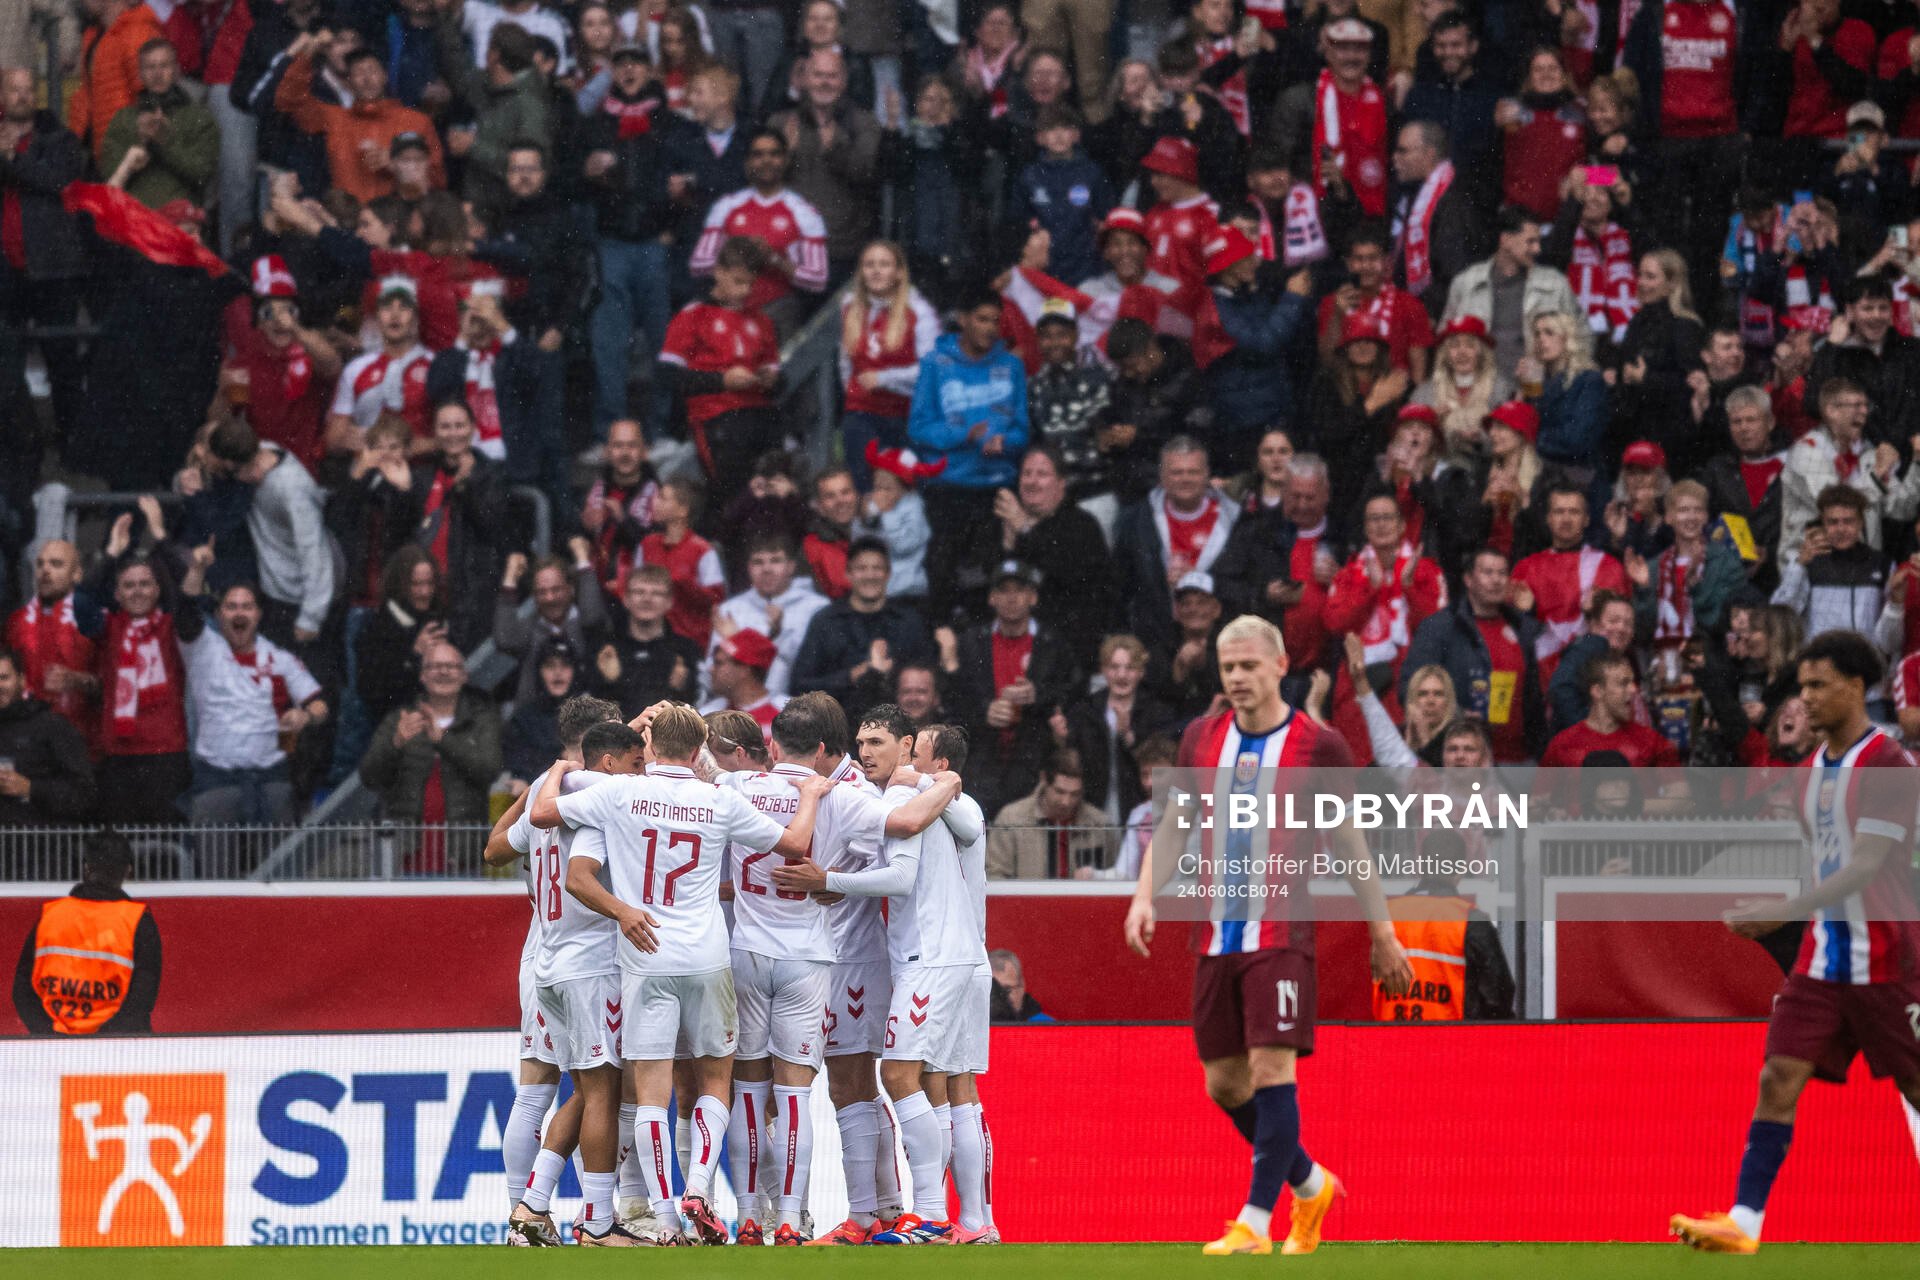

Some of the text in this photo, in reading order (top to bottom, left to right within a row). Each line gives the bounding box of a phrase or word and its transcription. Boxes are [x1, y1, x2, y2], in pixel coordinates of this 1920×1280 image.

[631, 799, 713, 824] KRISTIANSEN
[751, 794, 798, 814] HØJBJE
[535, 844, 562, 922] 18
[641, 828, 702, 906] 17
[1276, 979, 1299, 1019] 14
[884, 1016, 898, 1049] 6
[250, 1217, 389, 1246] Sammen
